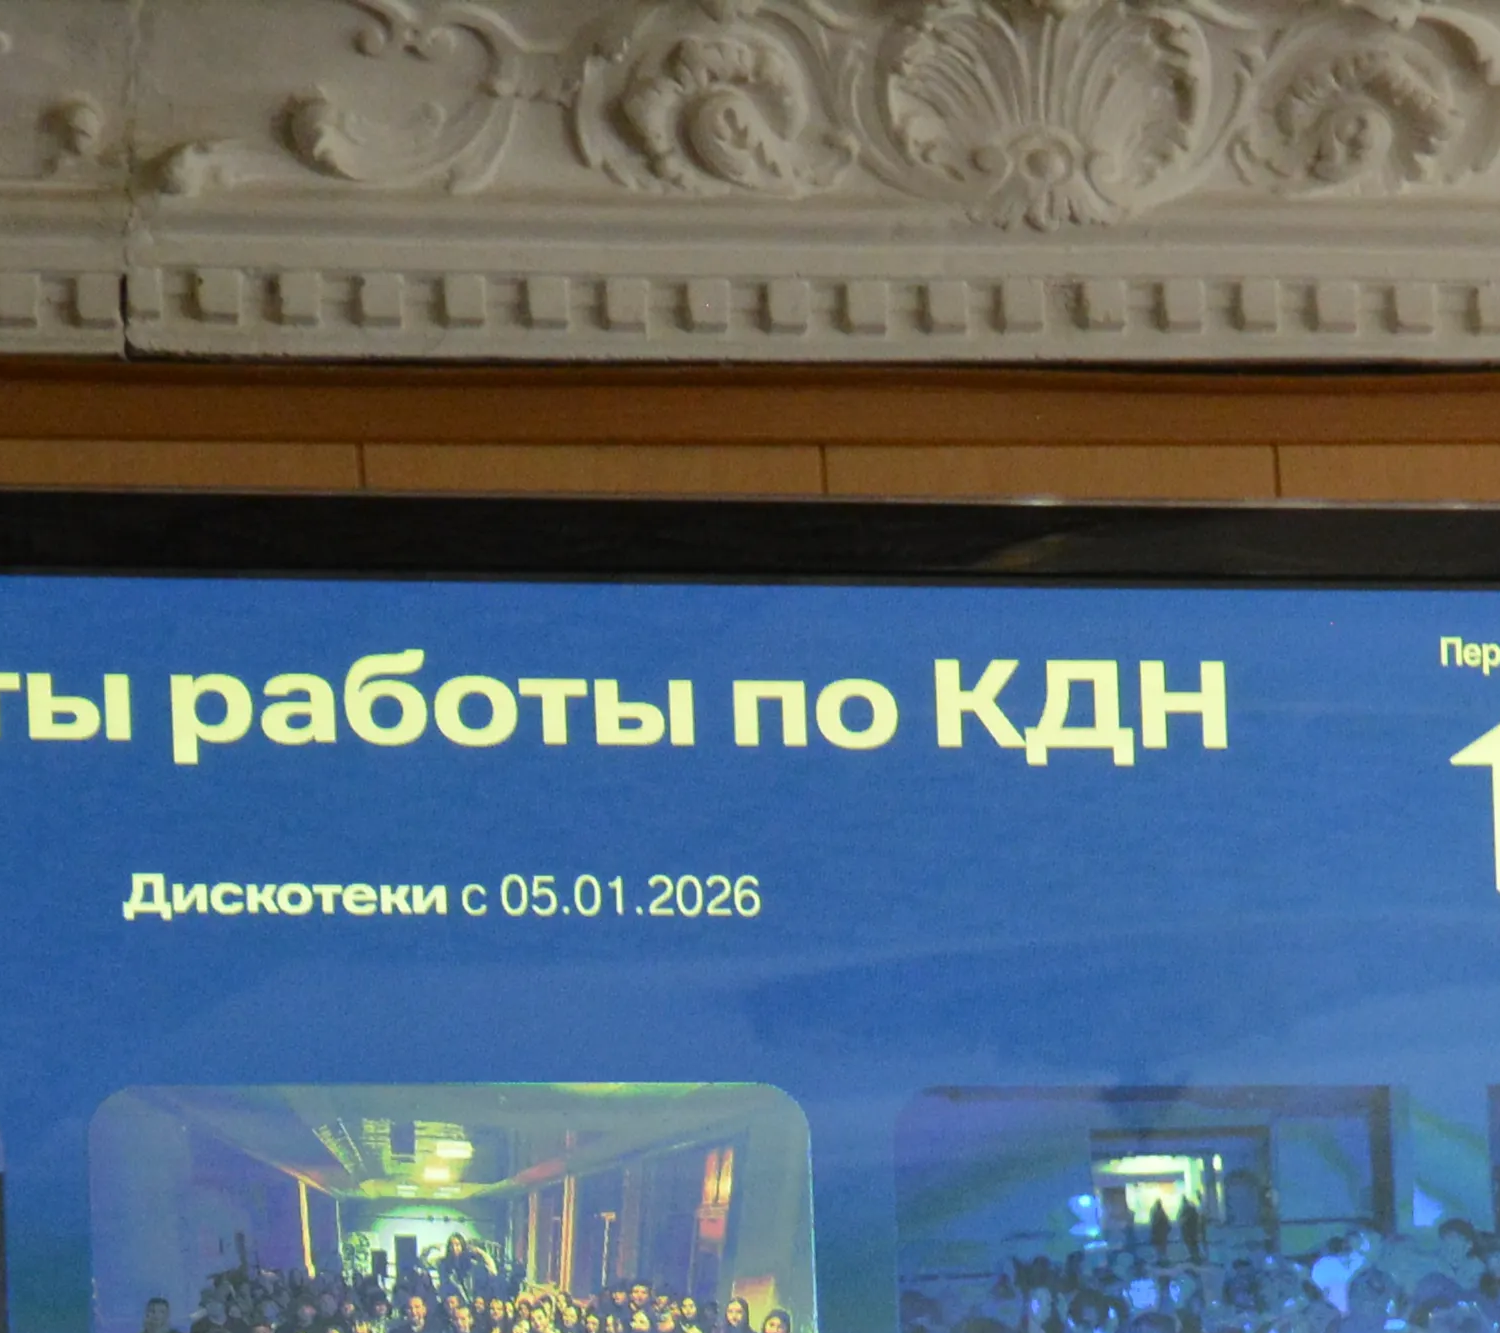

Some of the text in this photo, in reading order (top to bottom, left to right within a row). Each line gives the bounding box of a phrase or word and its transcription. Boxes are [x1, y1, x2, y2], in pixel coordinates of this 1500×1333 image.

[171, 649, 694, 764] работы
[733, 679, 898, 749] по
[935, 659, 1227, 766] КДН
[123, 873, 760, 920] Дискотеки с 05.01.2026
